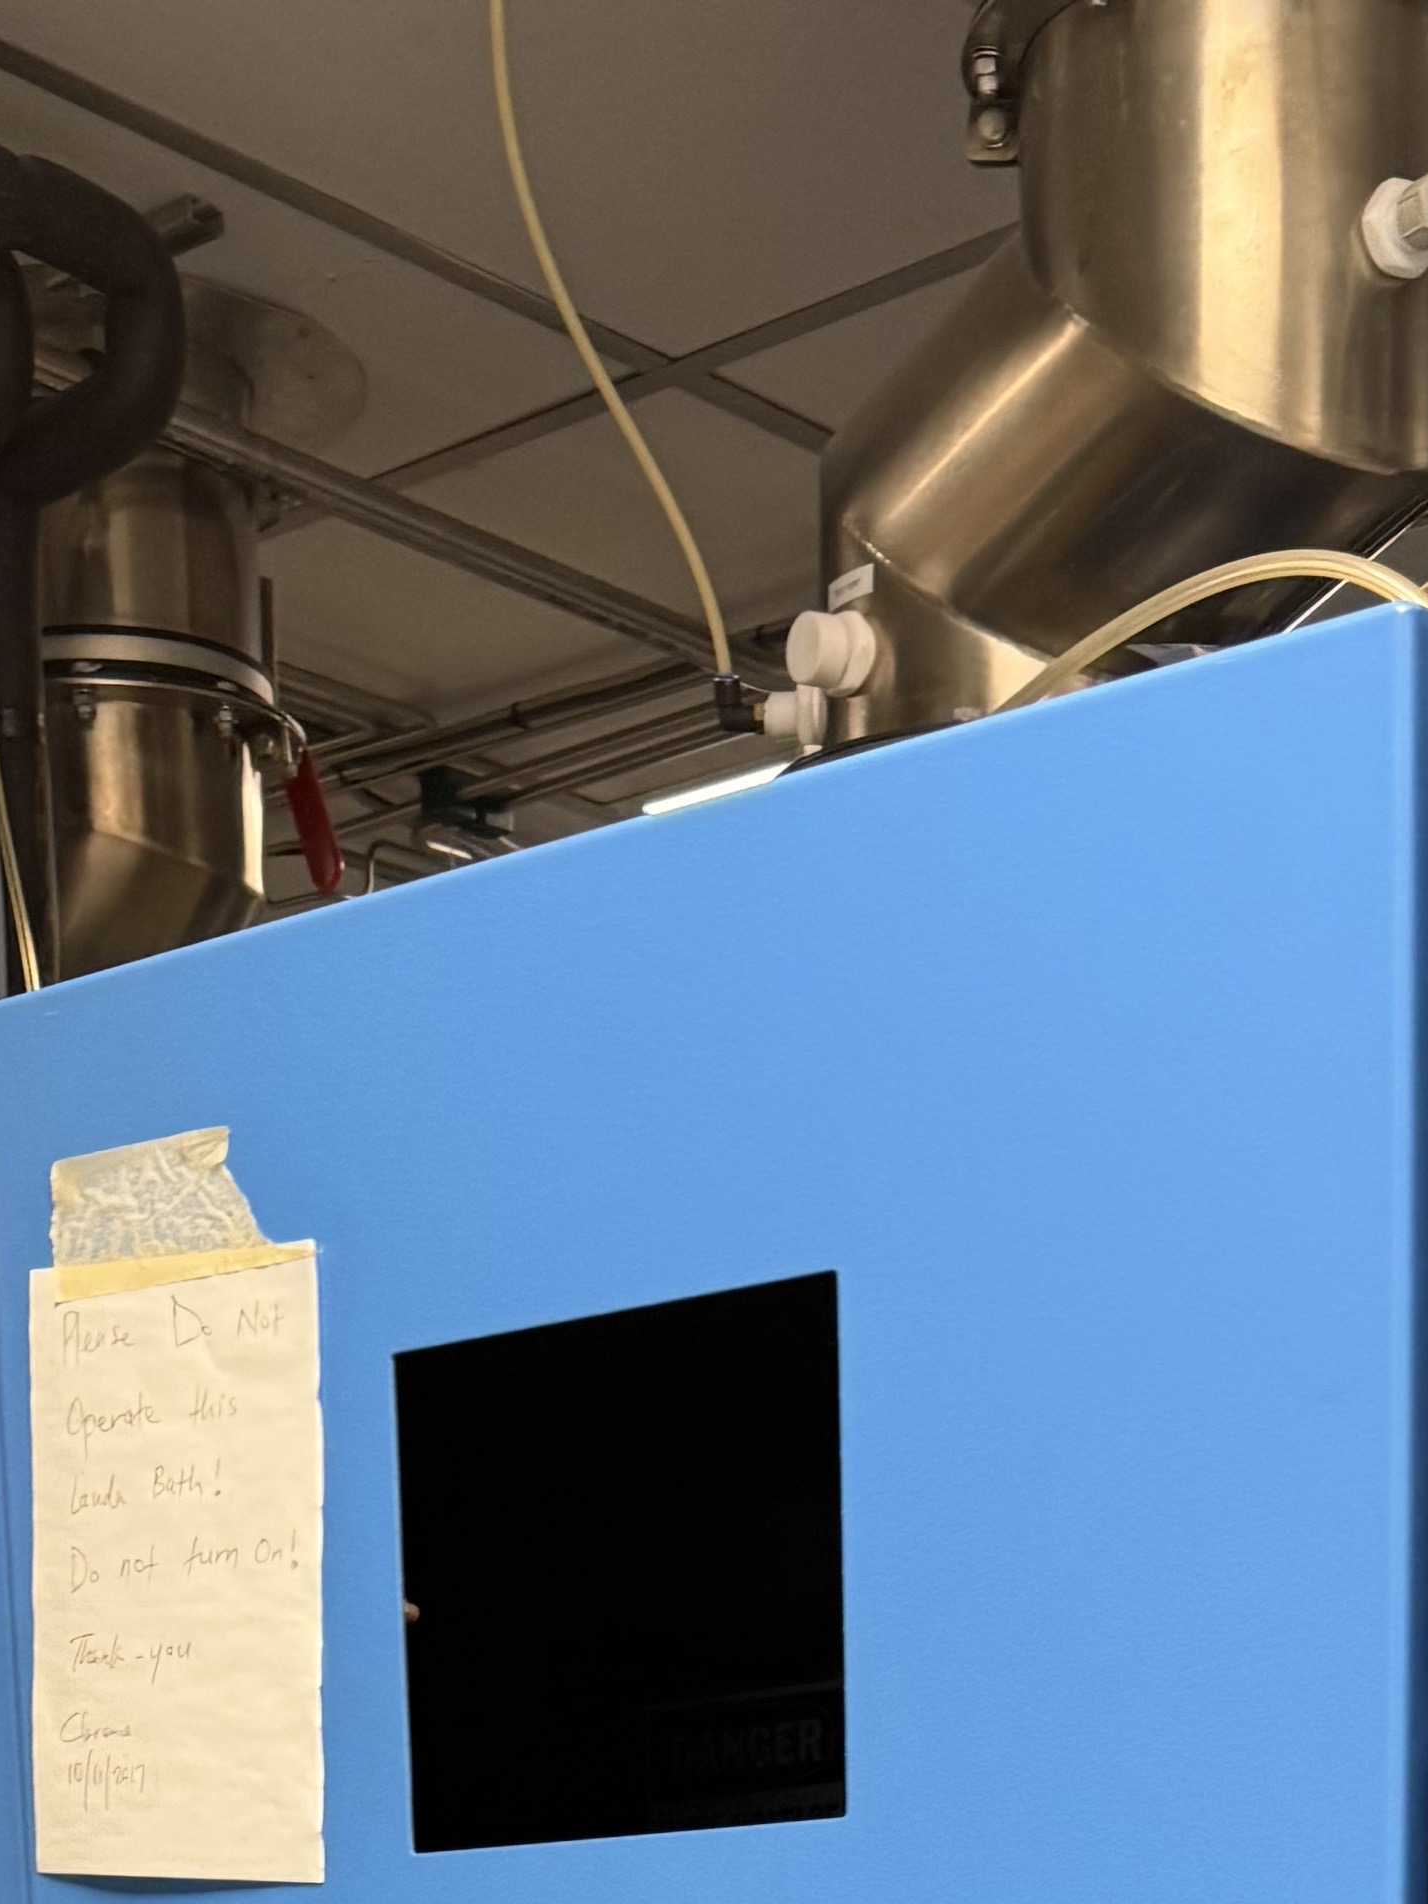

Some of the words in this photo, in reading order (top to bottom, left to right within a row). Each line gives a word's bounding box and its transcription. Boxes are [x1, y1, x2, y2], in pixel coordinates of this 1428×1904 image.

[63, 1309, 135, 1366] Please
[171, 1295, 212, 1347] Do
[236, 1300, 288, 1336] Not
[66, 1392, 161, 1460] Operate
[188, 1385, 238, 1427] this
[152, 1457, 222, 1498] Bath!
[70, 1546, 100, 1594] Do
[120, 1544, 159, 1581] not
[183, 1535, 239, 1577] turn
